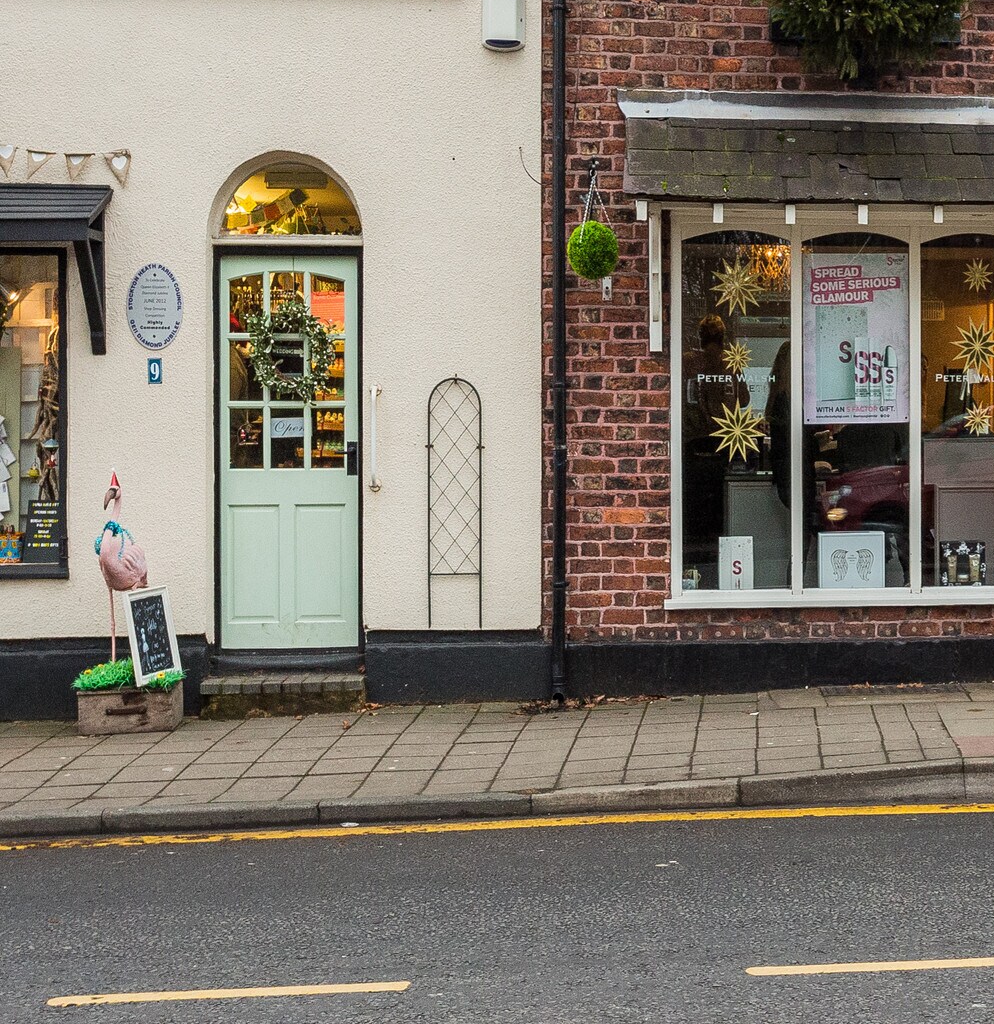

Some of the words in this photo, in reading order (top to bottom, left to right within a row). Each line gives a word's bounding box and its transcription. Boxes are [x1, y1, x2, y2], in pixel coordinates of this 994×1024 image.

[814, 267, 859, 279] SPREAD
[128, 276, 140, 311] STOCKTON
[138, 263, 157, 278] HEATH
[158, 264, 176, 283] PARISH
[173, 283, 182, 311] COUNCIL
[812, 280, 846, 293] SOME
[848, 277, 897, 290] SERIOUS
[812, 291, 869, 304] GLAMOUR
[136, 333, 163, 348] DIAMOND
[163, 321, 181, 346] JUBILEE
[838, 341, 852, 363] S
[150, 362, 160, 381] 9
[697, 373, 733, 383] PETER
[736, 373, 776, 383] WALSH
[935, 373, 969, 383] PETER
